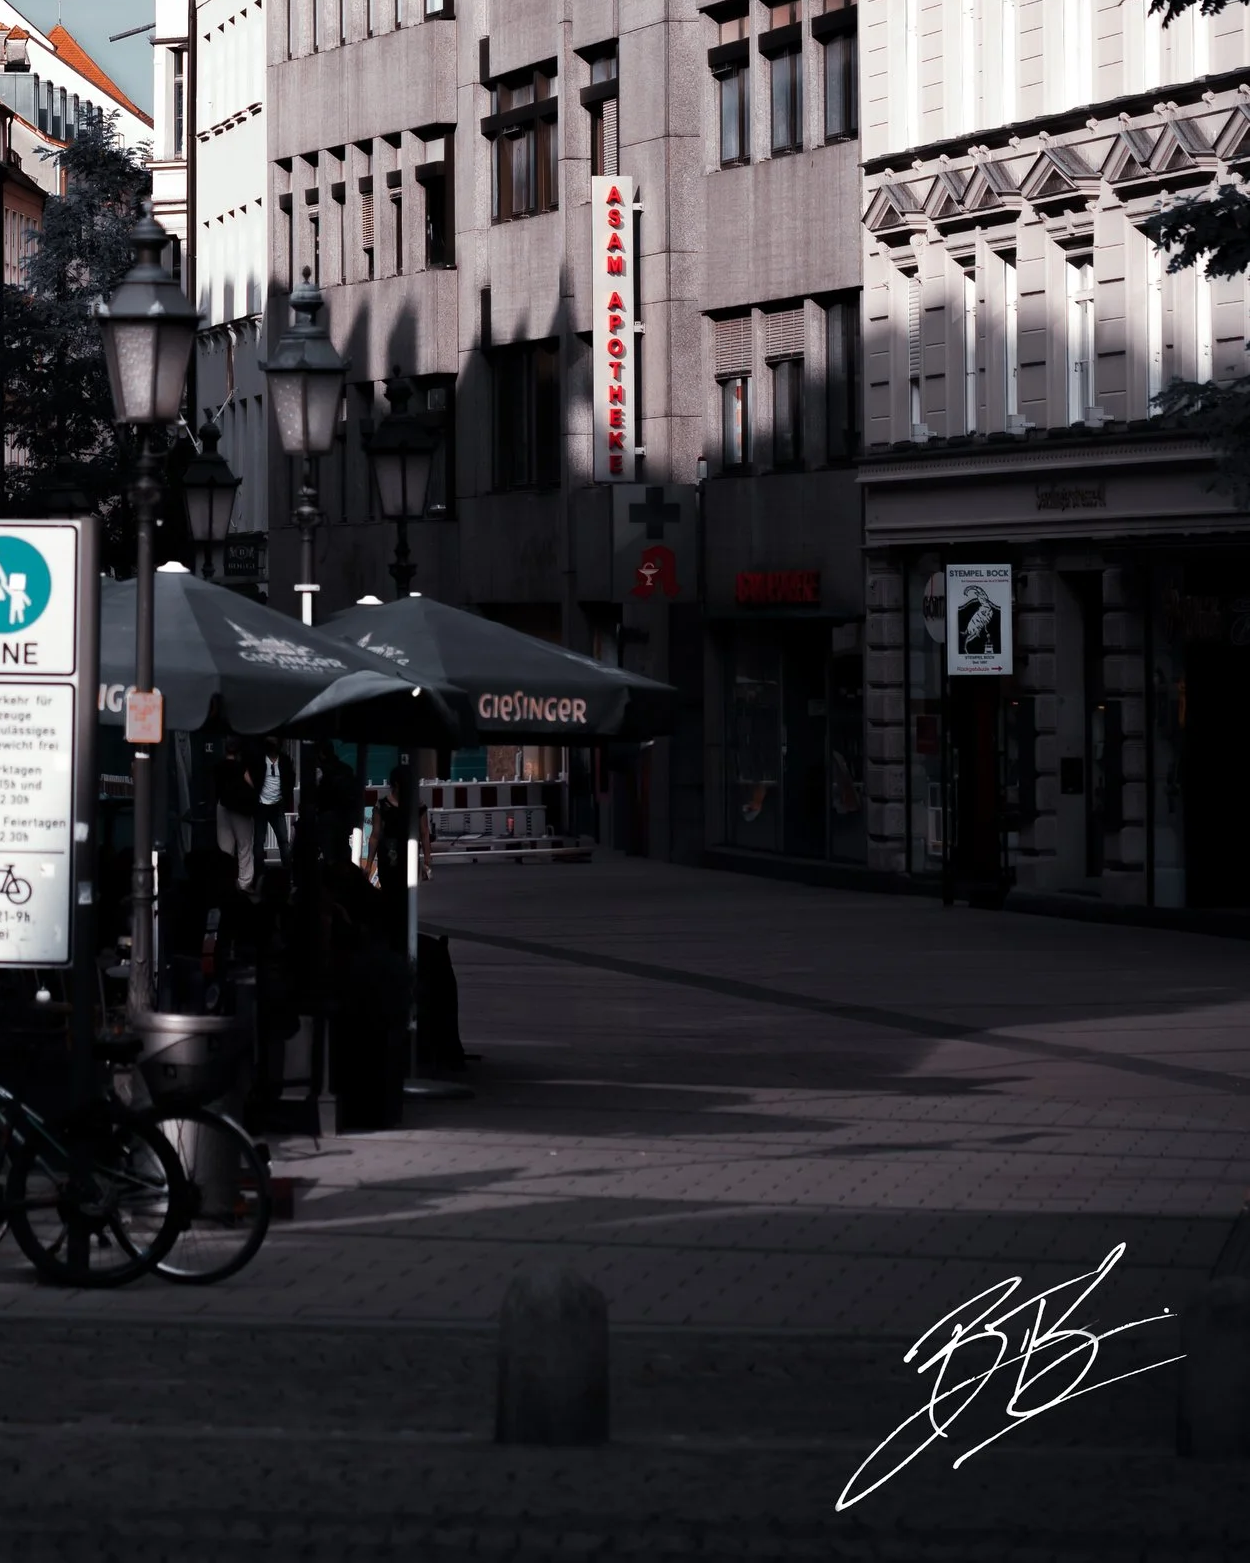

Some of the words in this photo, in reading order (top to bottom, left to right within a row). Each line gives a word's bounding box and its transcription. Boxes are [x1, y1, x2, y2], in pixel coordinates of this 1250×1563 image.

[606, 185, 624, 274] ASAM
[607, 291, 625, 475] APOTHEKE
[949, 569, 984, 577] STEMPEL
[986, 569, 1009, 577] BOCK
[36, 694, 53, 706] für
[38, 740, 59, 751] frei
[20, 780, 42, 791] und
[3, 816, 66, 830] Feiertagen
